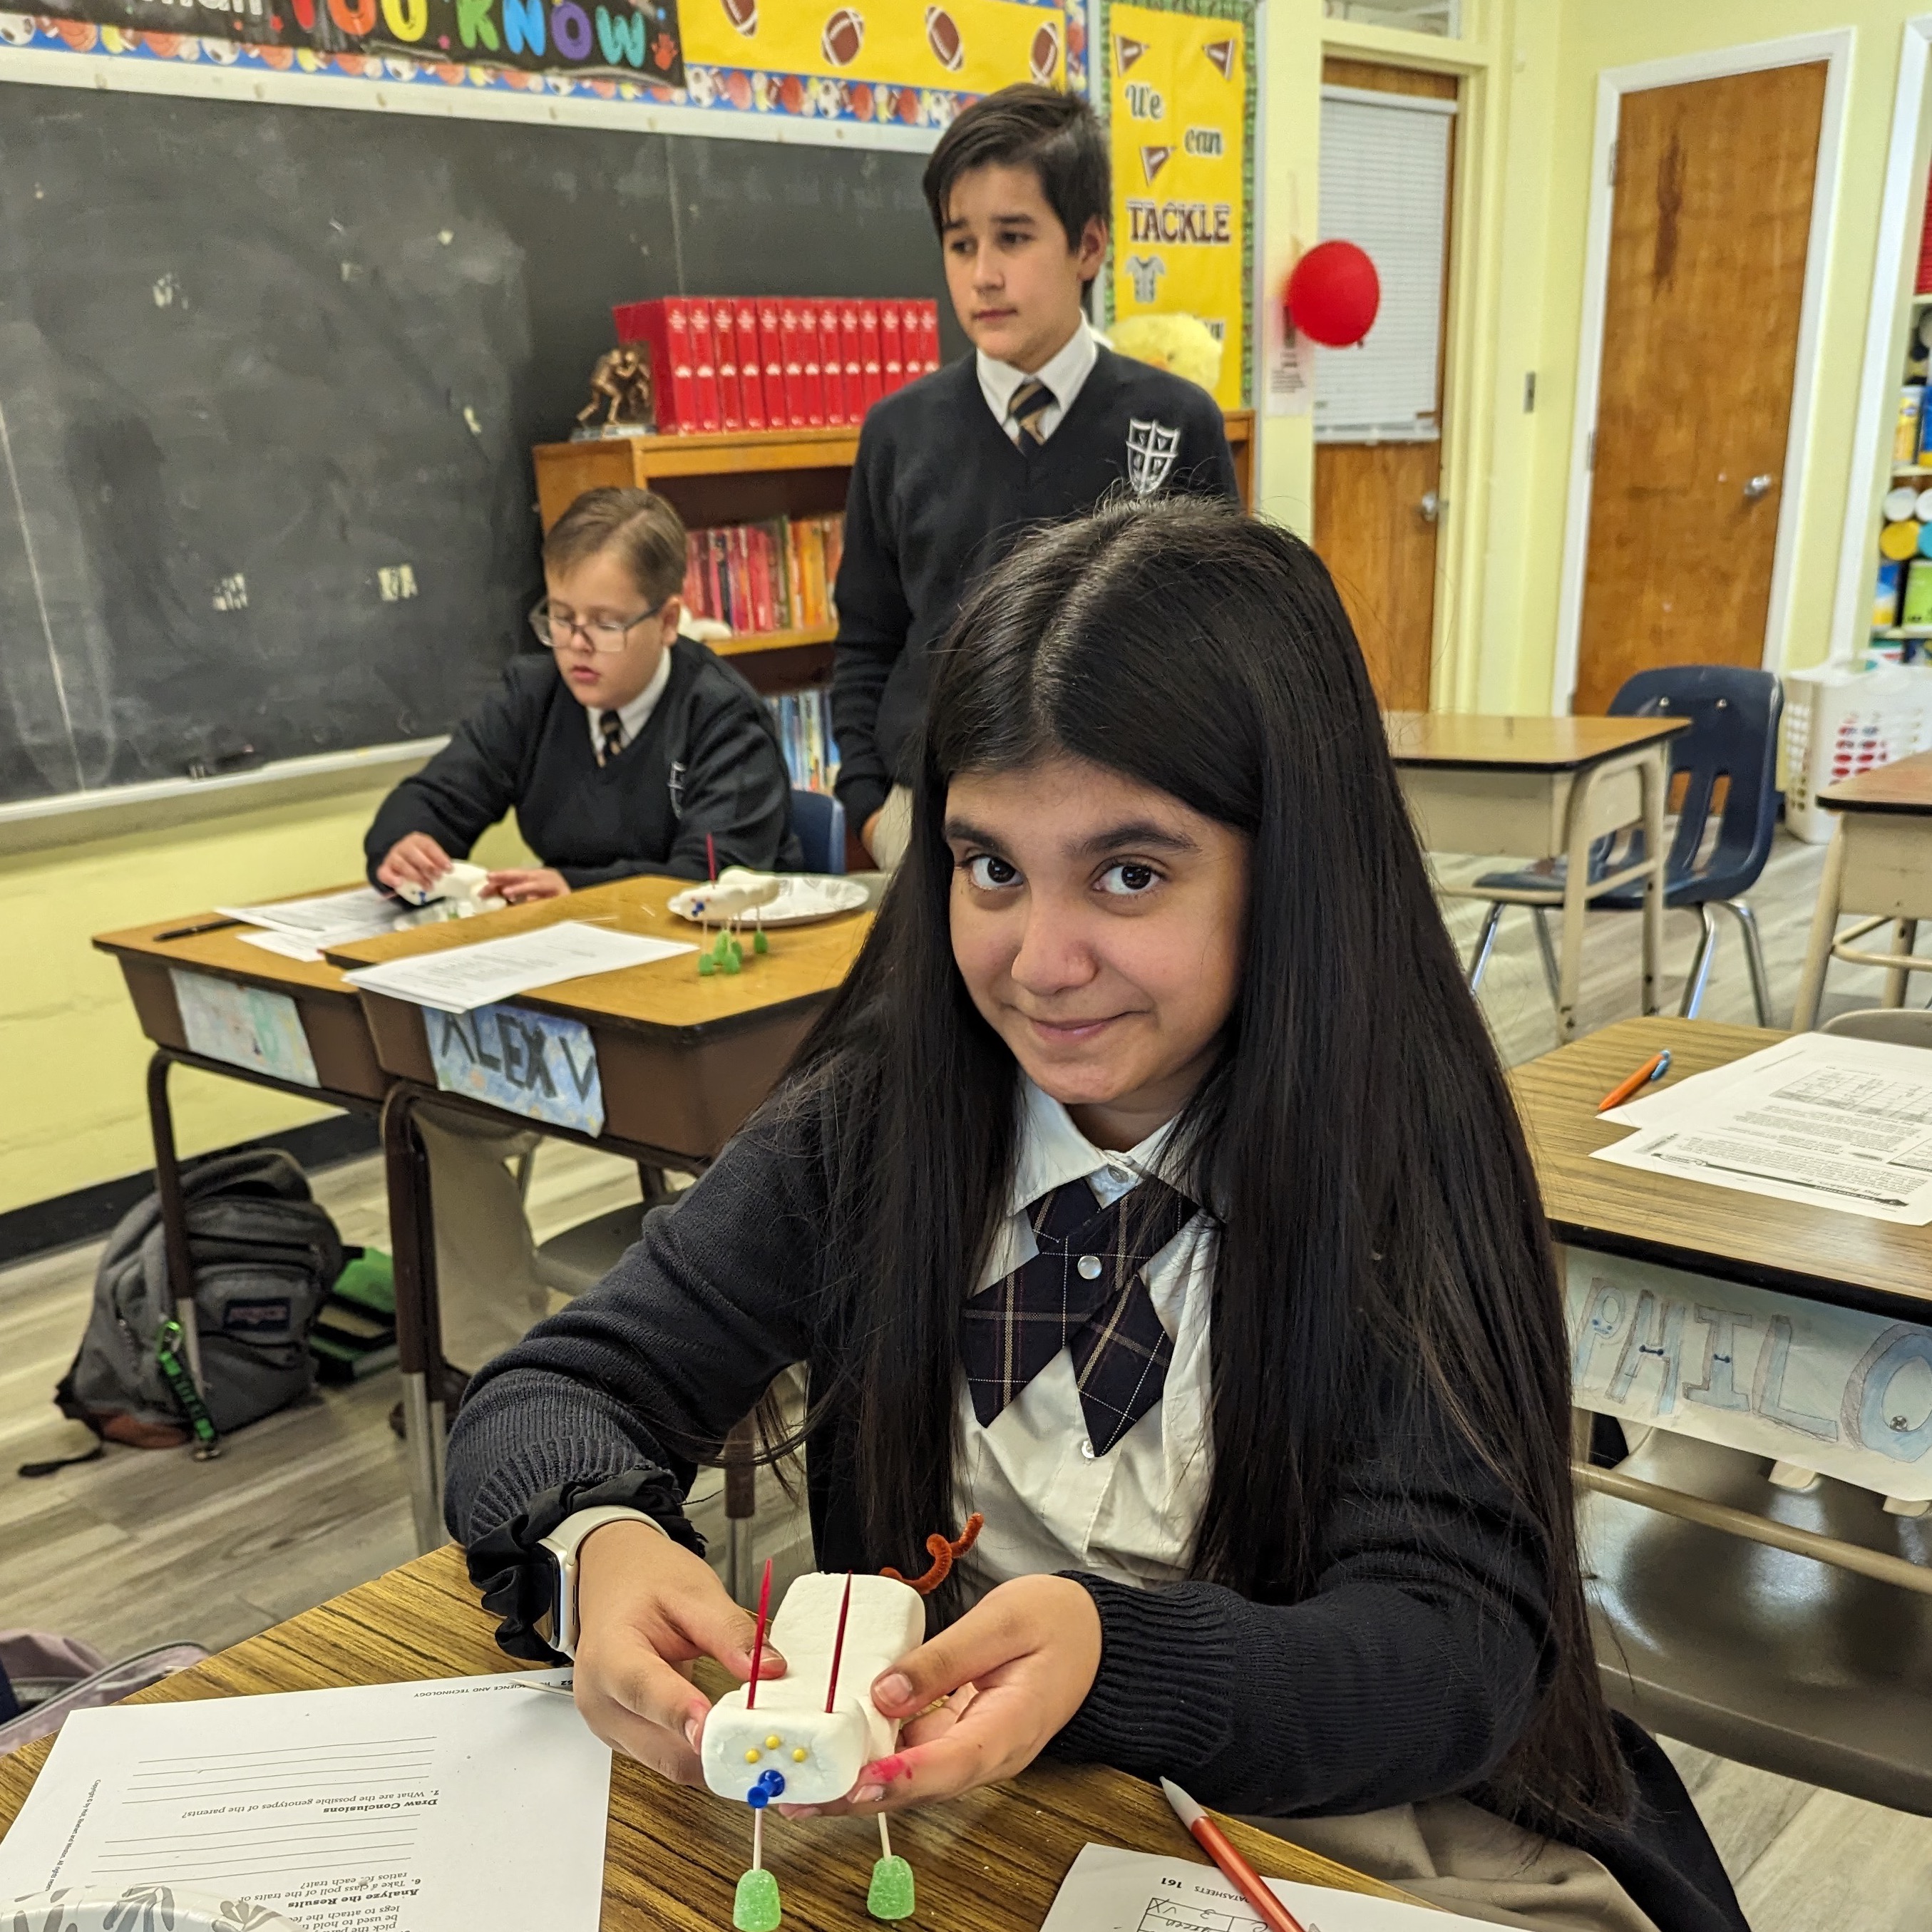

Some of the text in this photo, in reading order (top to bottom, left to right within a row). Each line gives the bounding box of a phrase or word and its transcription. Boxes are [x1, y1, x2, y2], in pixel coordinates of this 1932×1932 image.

[456, 0, 645, 68] KNOW
[1119, 83, 1164, 119] We
[1184, 128, 1223, 156] can
[1126, 200, 1230, 244] TACKLE
[441, 1012, 597, 1102] ALEX V
[413, 1689, 469, 1697] TECHNOLOGY
[262, 1798, 313, 1809] genotypes
[315, 1795, 356, 1805] possible
[323, 1799, 438, 1813] Draw Conclusions
[181, 1807, 225, 1819] parents?
[332, 1878, 356, 1886] each
[378, 1872, 407, 1881] ratios
[300, 1880, 327, 1890] trait?
[344, 1882, 369, 1891] class
[381, 1879, 405, 1889] Take
[1161, 1877, 1182, 1889] 161
[319, 1884, 341, 1895] poll
[254, 1893, 281, 1901] traits
[287, 1888, 419, 1908] Analyze the Results
[328, 1909, 361, 1921] attach
[379, 1904, 399, 1916] legs
[305, 1913, 323, 1922] the
[341, 1918, 352, 1927] to
[356, 1915, 381, 1926] used
[384, 1913, 397, 1922] be
[312, 1920, 339, 1931] hold
[372, 1919, 396, 1931] pick
